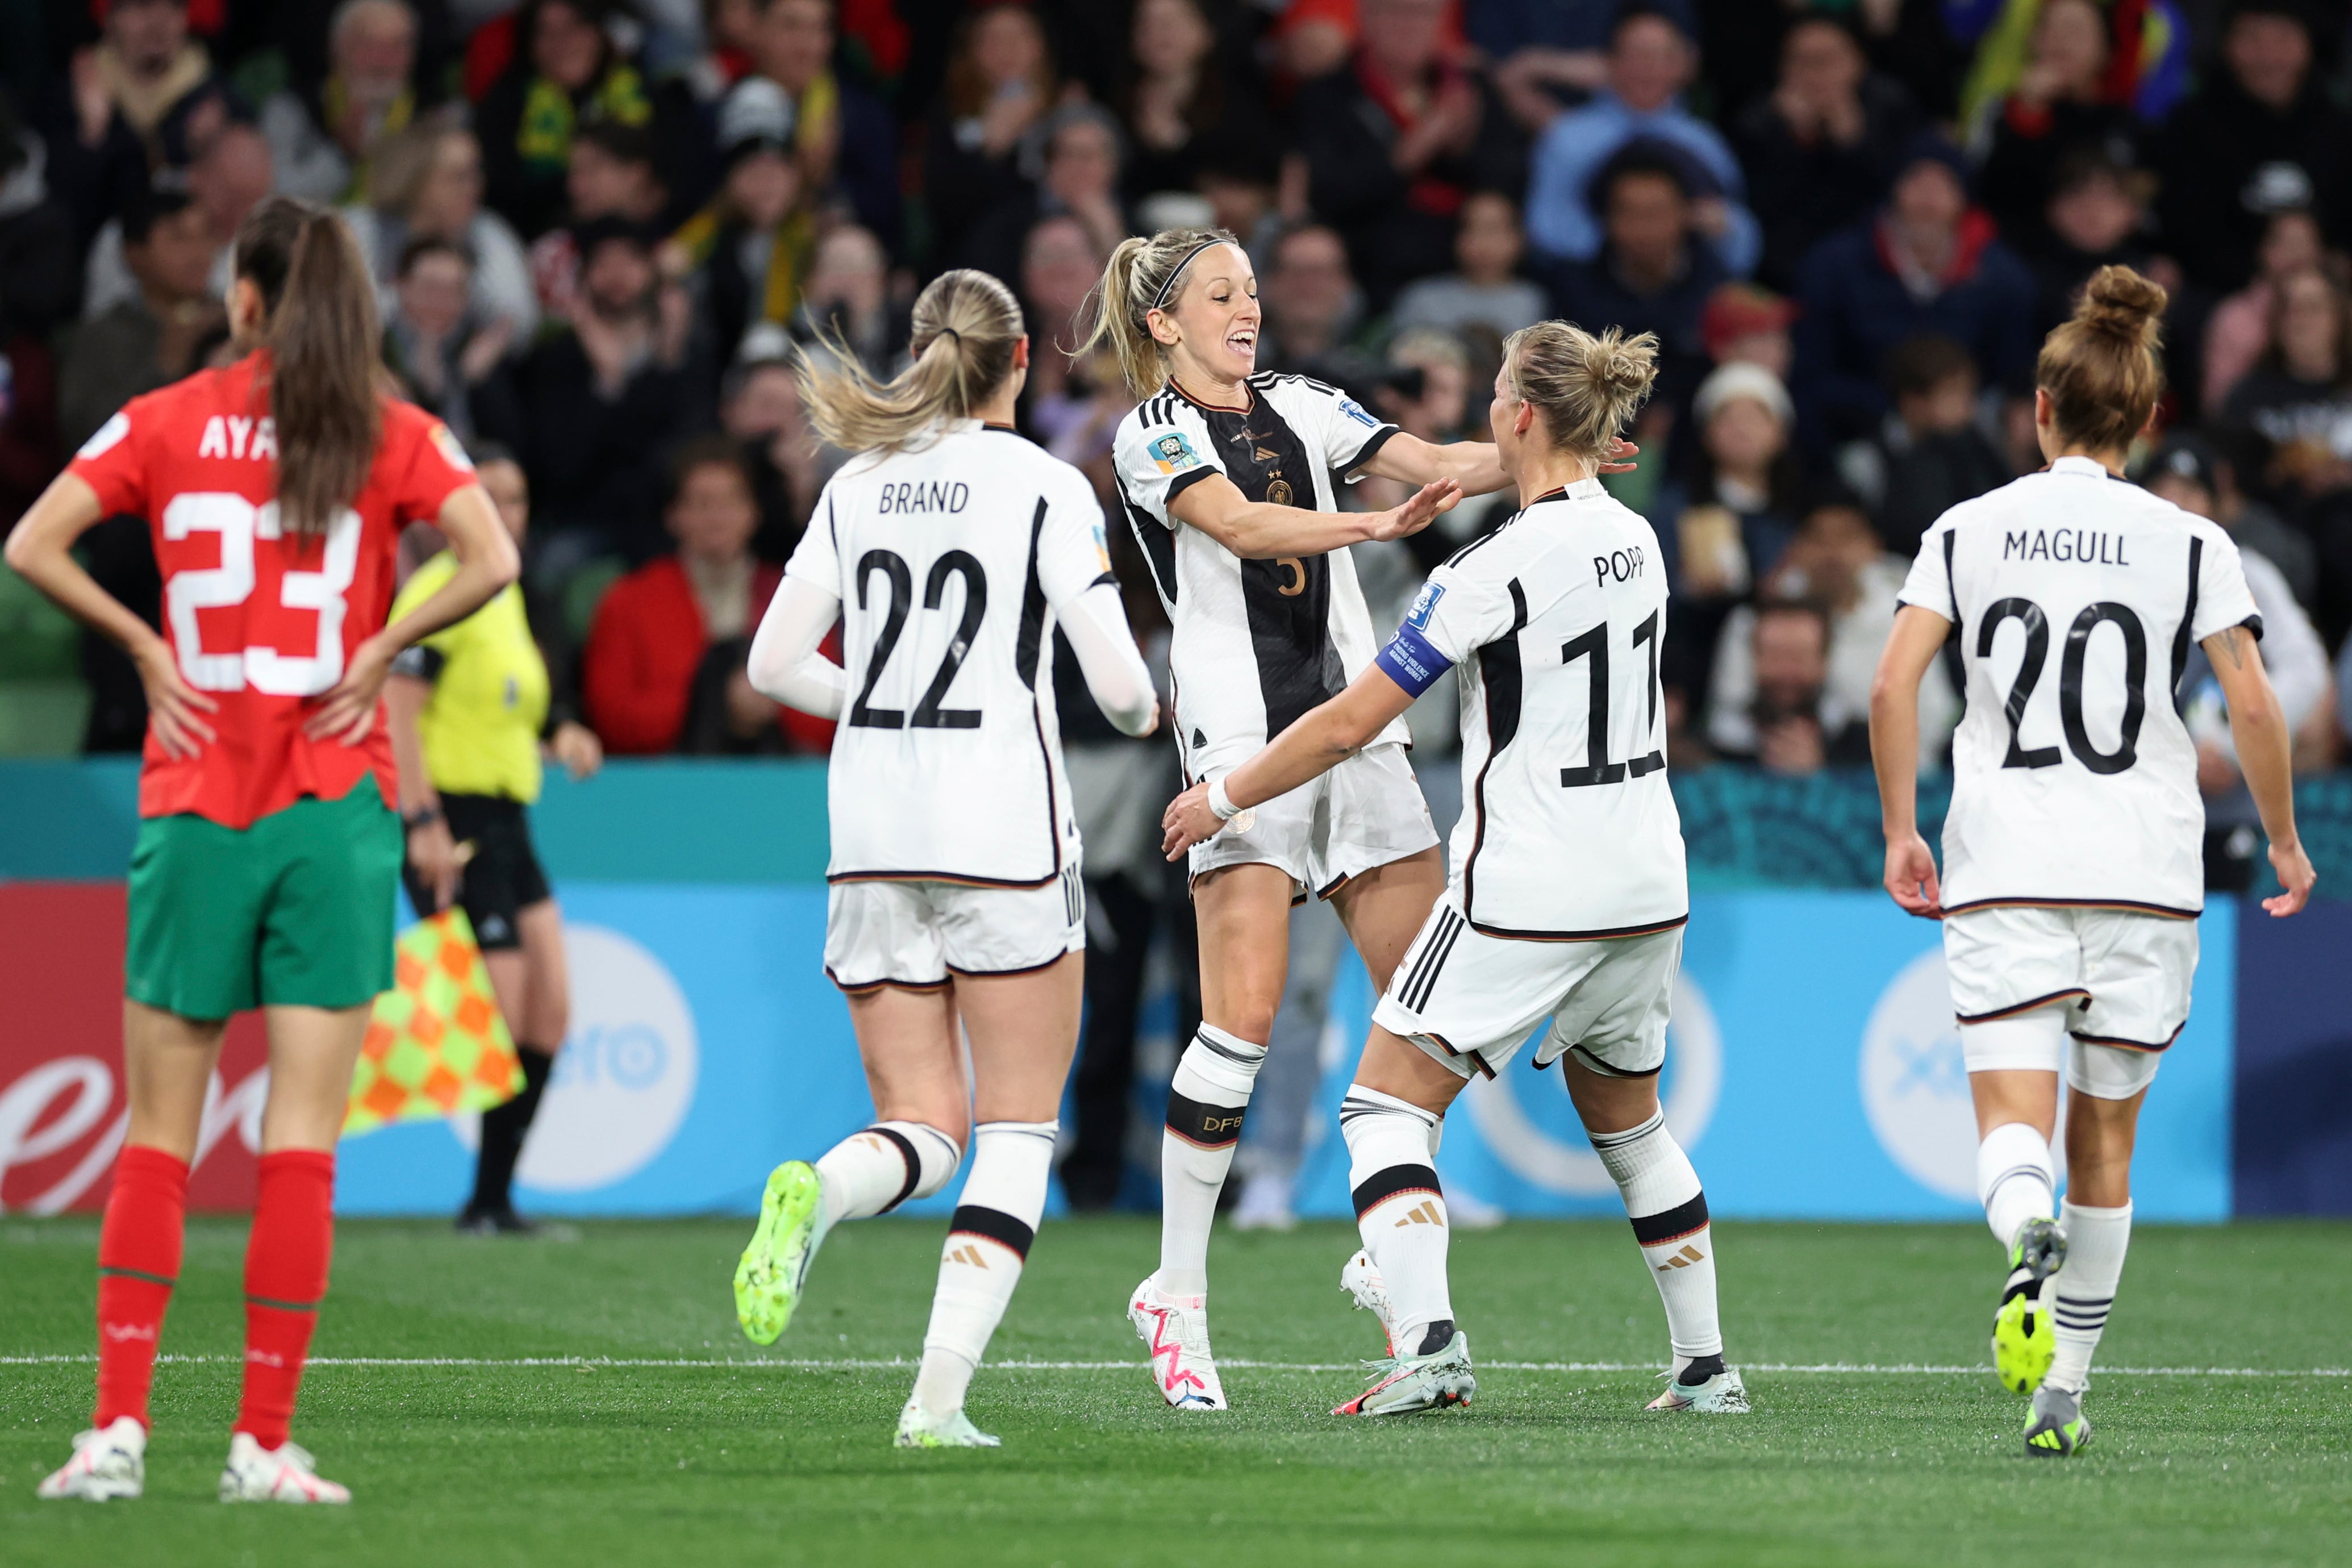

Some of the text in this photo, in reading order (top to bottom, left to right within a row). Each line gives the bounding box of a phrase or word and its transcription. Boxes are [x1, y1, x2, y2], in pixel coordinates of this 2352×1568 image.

[199, 415, 278, 461] AYA
[879, 482, 969, 514] BRAND
[1594, 546, 1644, 587] POPP
[2003, 529, 2130, 566] MAGULL
[163, 492, 362, 696] 23
[849, 549, 987, 729] 22
[1388, 649, 1424, 682] AGAINST WOMEN
[1393, 643, 1430, 678] ENDING VIOLENCE
[1560, 607, 1666, 788] 11
[1977, 597, 2147, 774] 20
[1203, 1116, 1243, 1132] DFB
